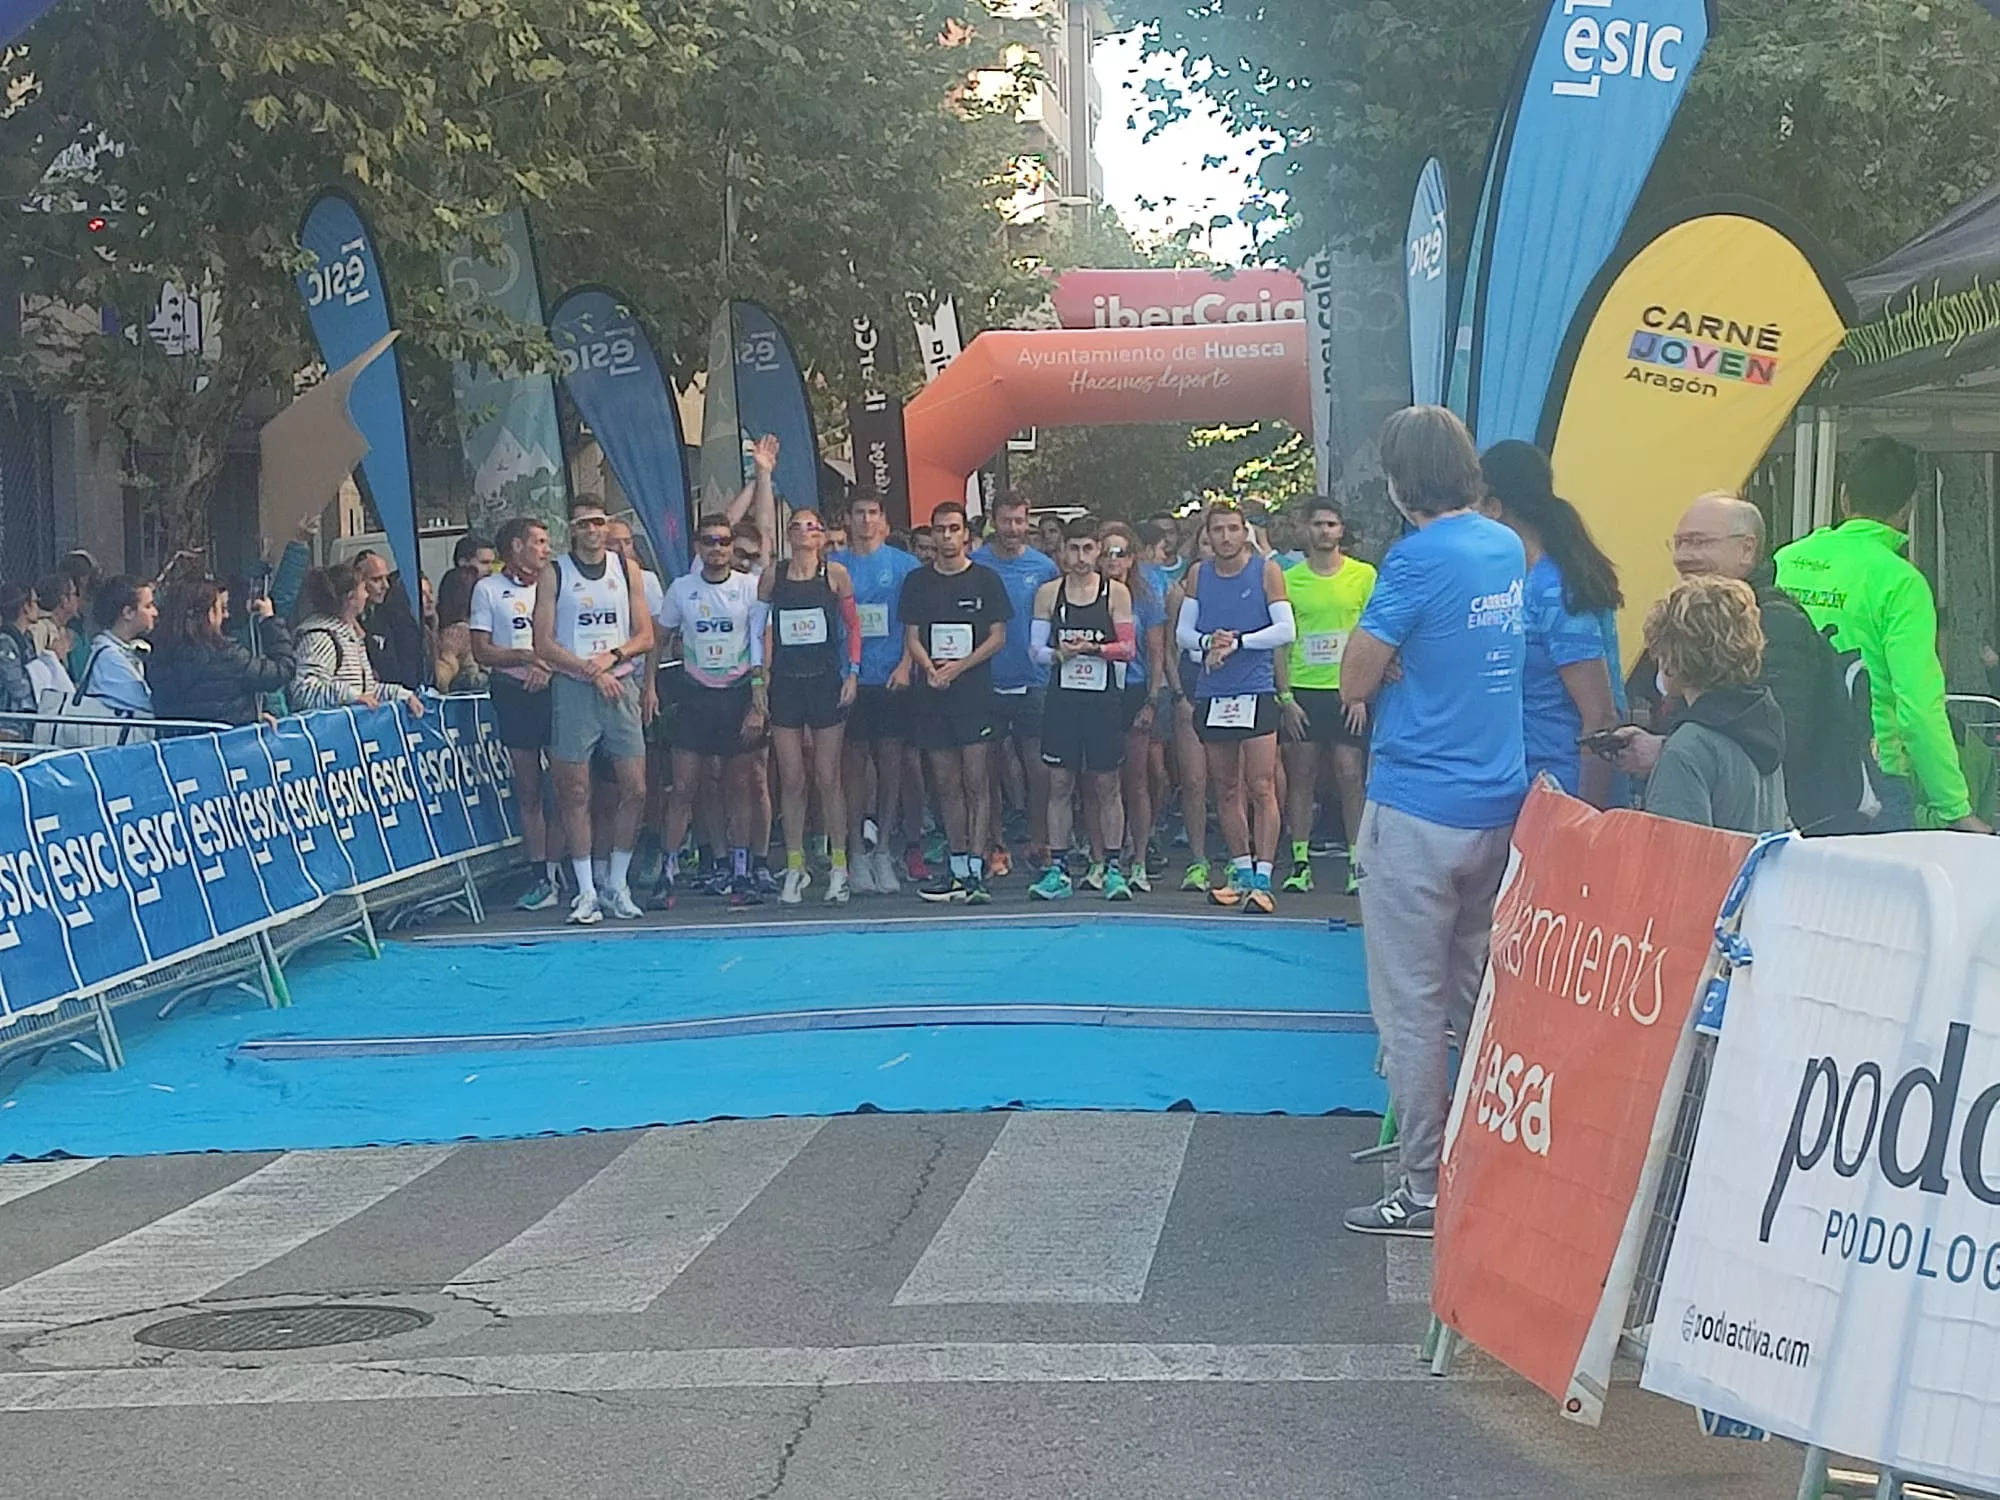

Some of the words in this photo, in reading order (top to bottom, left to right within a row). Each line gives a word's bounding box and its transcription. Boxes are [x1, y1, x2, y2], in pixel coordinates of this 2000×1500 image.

[1642, 305, 1782, 352] CARNÉ
[1016, 345, 1165, 370] Ayuntamiento
[1172, 344, 1198, 361] de
[1204, 341, 1286, 360] Huesca
[1634, 335, 1777, 383] JOVEN
[1068, 369, 1155, 394] Hacemos
[1157, 364, 1232, 397] deporte
[1624, 366, 1718, 398] Aragón
[1075, 663, 1093, 675] 20
